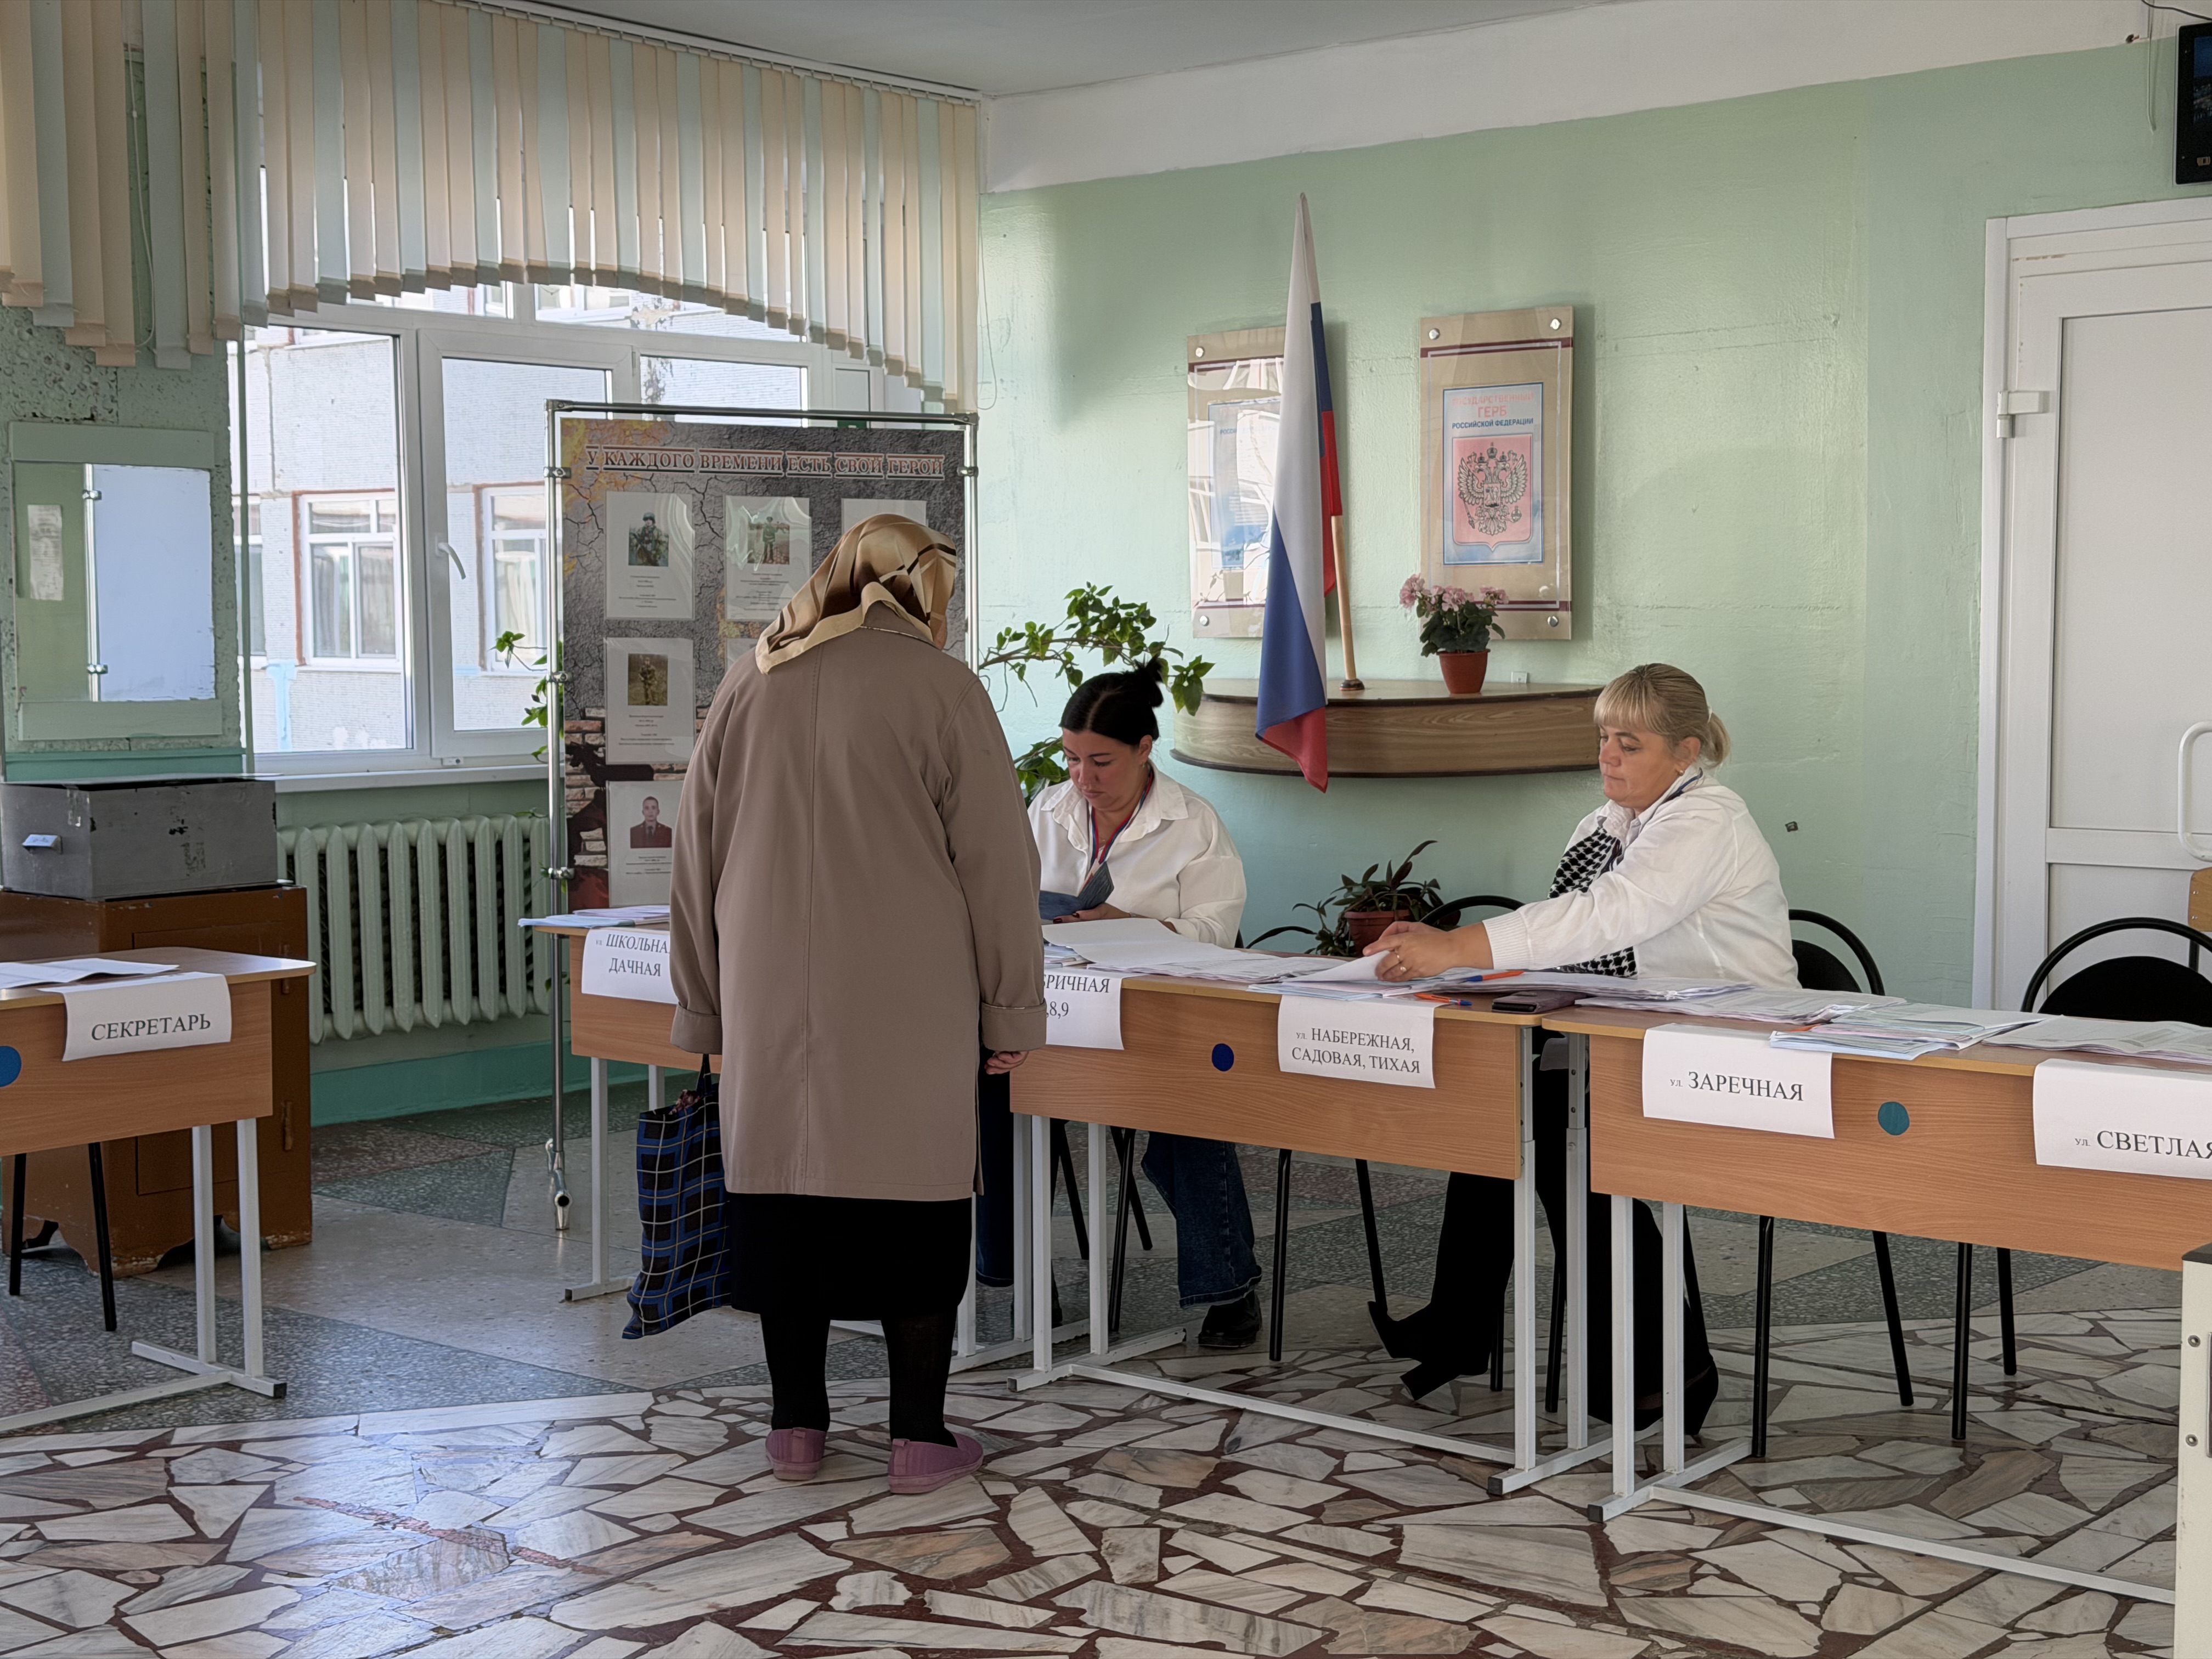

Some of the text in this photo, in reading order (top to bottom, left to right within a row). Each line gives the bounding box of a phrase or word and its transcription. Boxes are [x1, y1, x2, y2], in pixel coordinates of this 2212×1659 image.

[1452, 417, 1533, 429] РОССИЙСКОЙ ФЕДЕРАЦИИ
[1477, 406, 1507, 418] ГЕРБ
[588, 450, 943, 475] У КАЖДОГО ВРЕМЕНИ ЕСТЬ СВОЙ ГЕРОЙ
[606, 933, 670, 954] ШКОЛЬНА
[608, 957, 662, 977] ДАЧНАЯ
[1043, 974, 1110, 993] РИЧНАЯ
[91, 1013, 211, 1041] СЕКРЕТАРЬ
[1311, 1028, 1415, 1053] НАБЕРЕЖНАЯ,
[1291, 1047, 1421, 1074] САДОВАЯ, ТИХАЯ
[1688, 1071, 1804, 1102] ЗАРЕЧНАЯ
